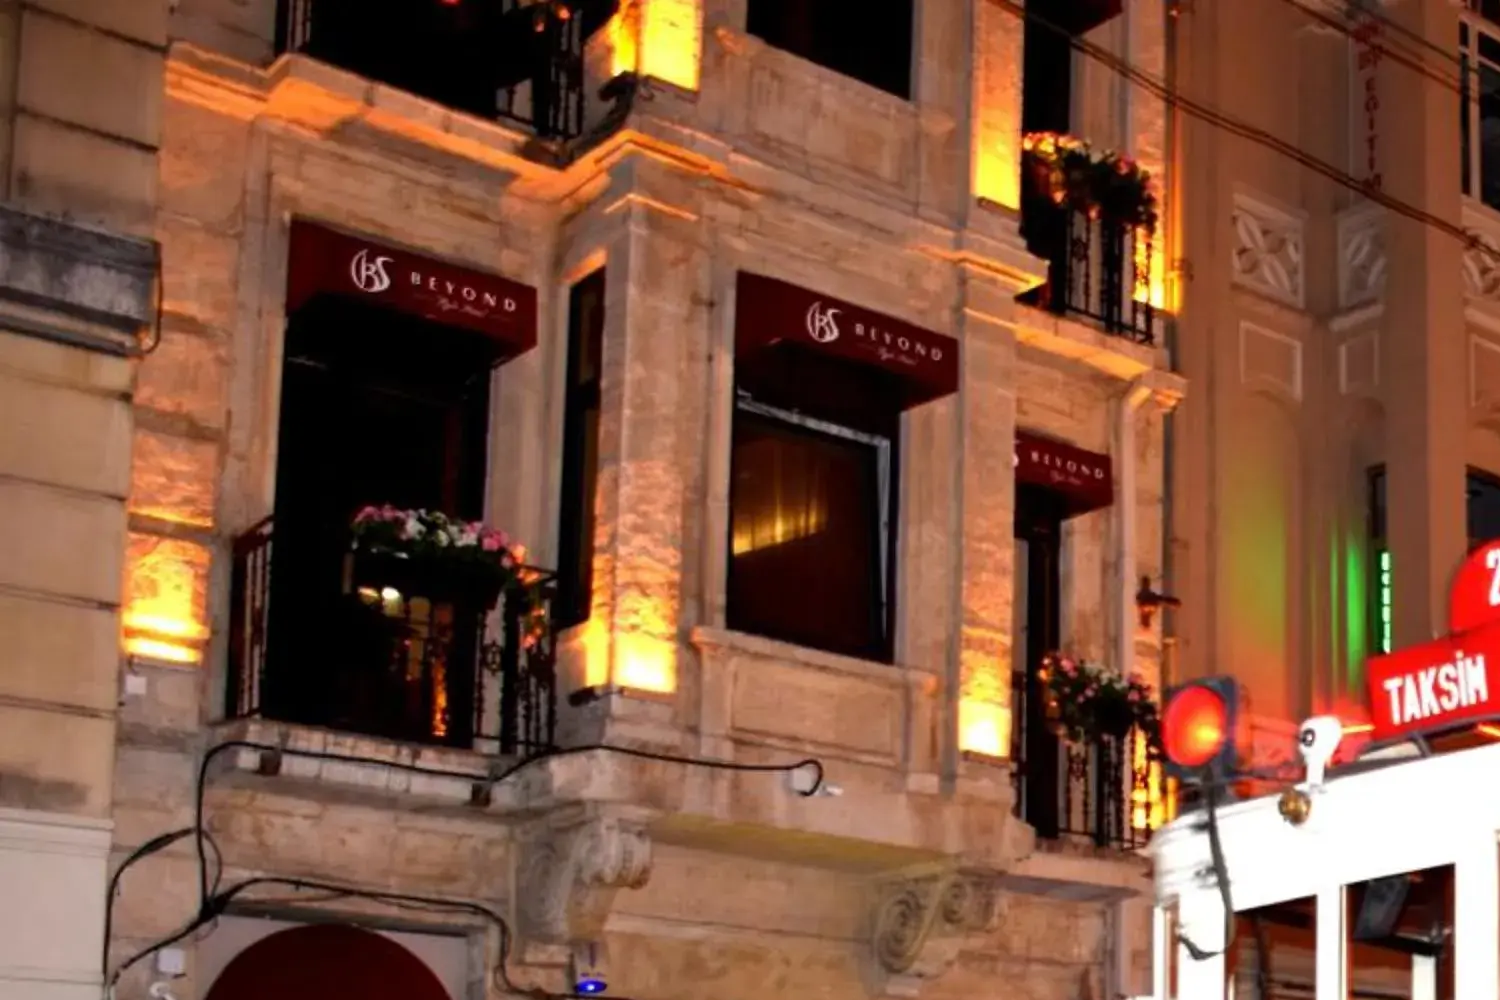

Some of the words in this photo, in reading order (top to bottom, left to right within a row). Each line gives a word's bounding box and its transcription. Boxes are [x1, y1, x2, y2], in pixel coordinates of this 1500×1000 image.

[411, 271, 517, 312] BEYOND
[855, 323, 942, 361] BEYOND
[1031, 450, 1104, 479] BEYOND
[1383, 650, 1489, 726] TAKSİM
